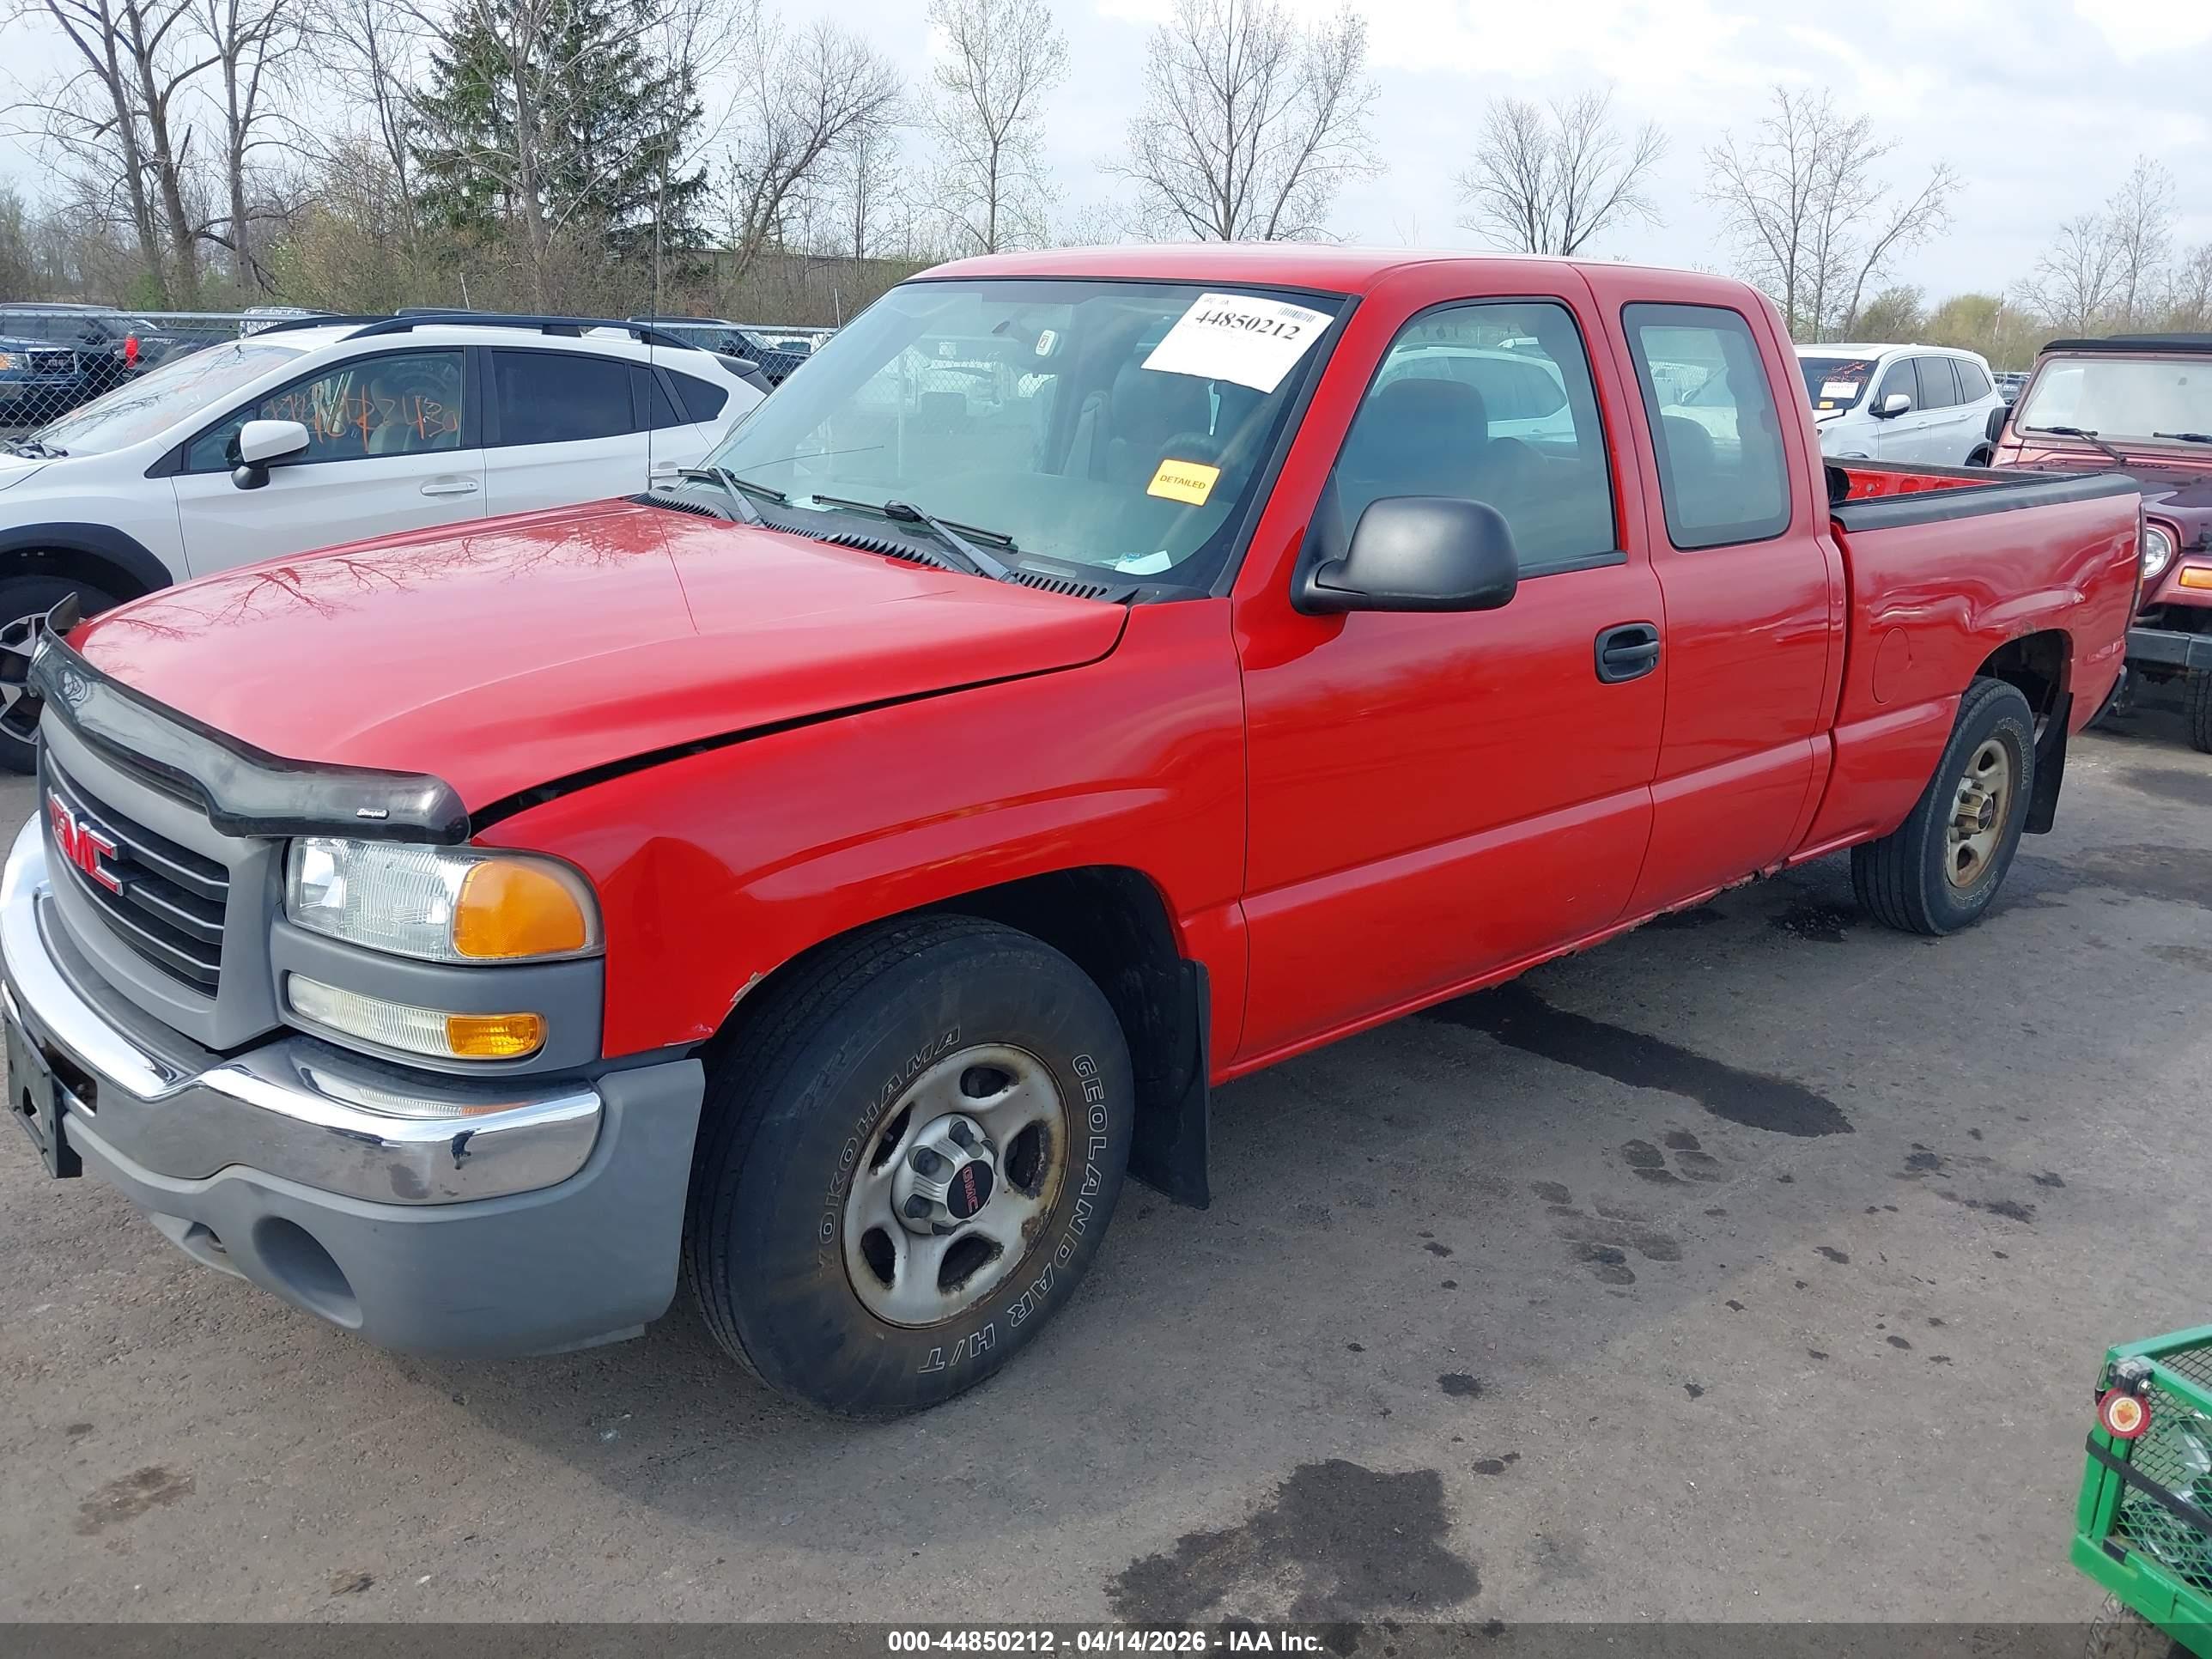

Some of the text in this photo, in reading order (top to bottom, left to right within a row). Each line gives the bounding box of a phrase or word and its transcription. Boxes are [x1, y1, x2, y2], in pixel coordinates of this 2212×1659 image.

[1194, 309, 1301, 340] 44850212
[1159, 474, 1206, 489] DETAILED
[48, 793, 125, 896] GMC
[817, 1024, 962, 1279] YOKOHAMA
[916, 1053, 1109, 1374] GEOLANDAR H/T
[962, 1166, 979, 1214] GMC
